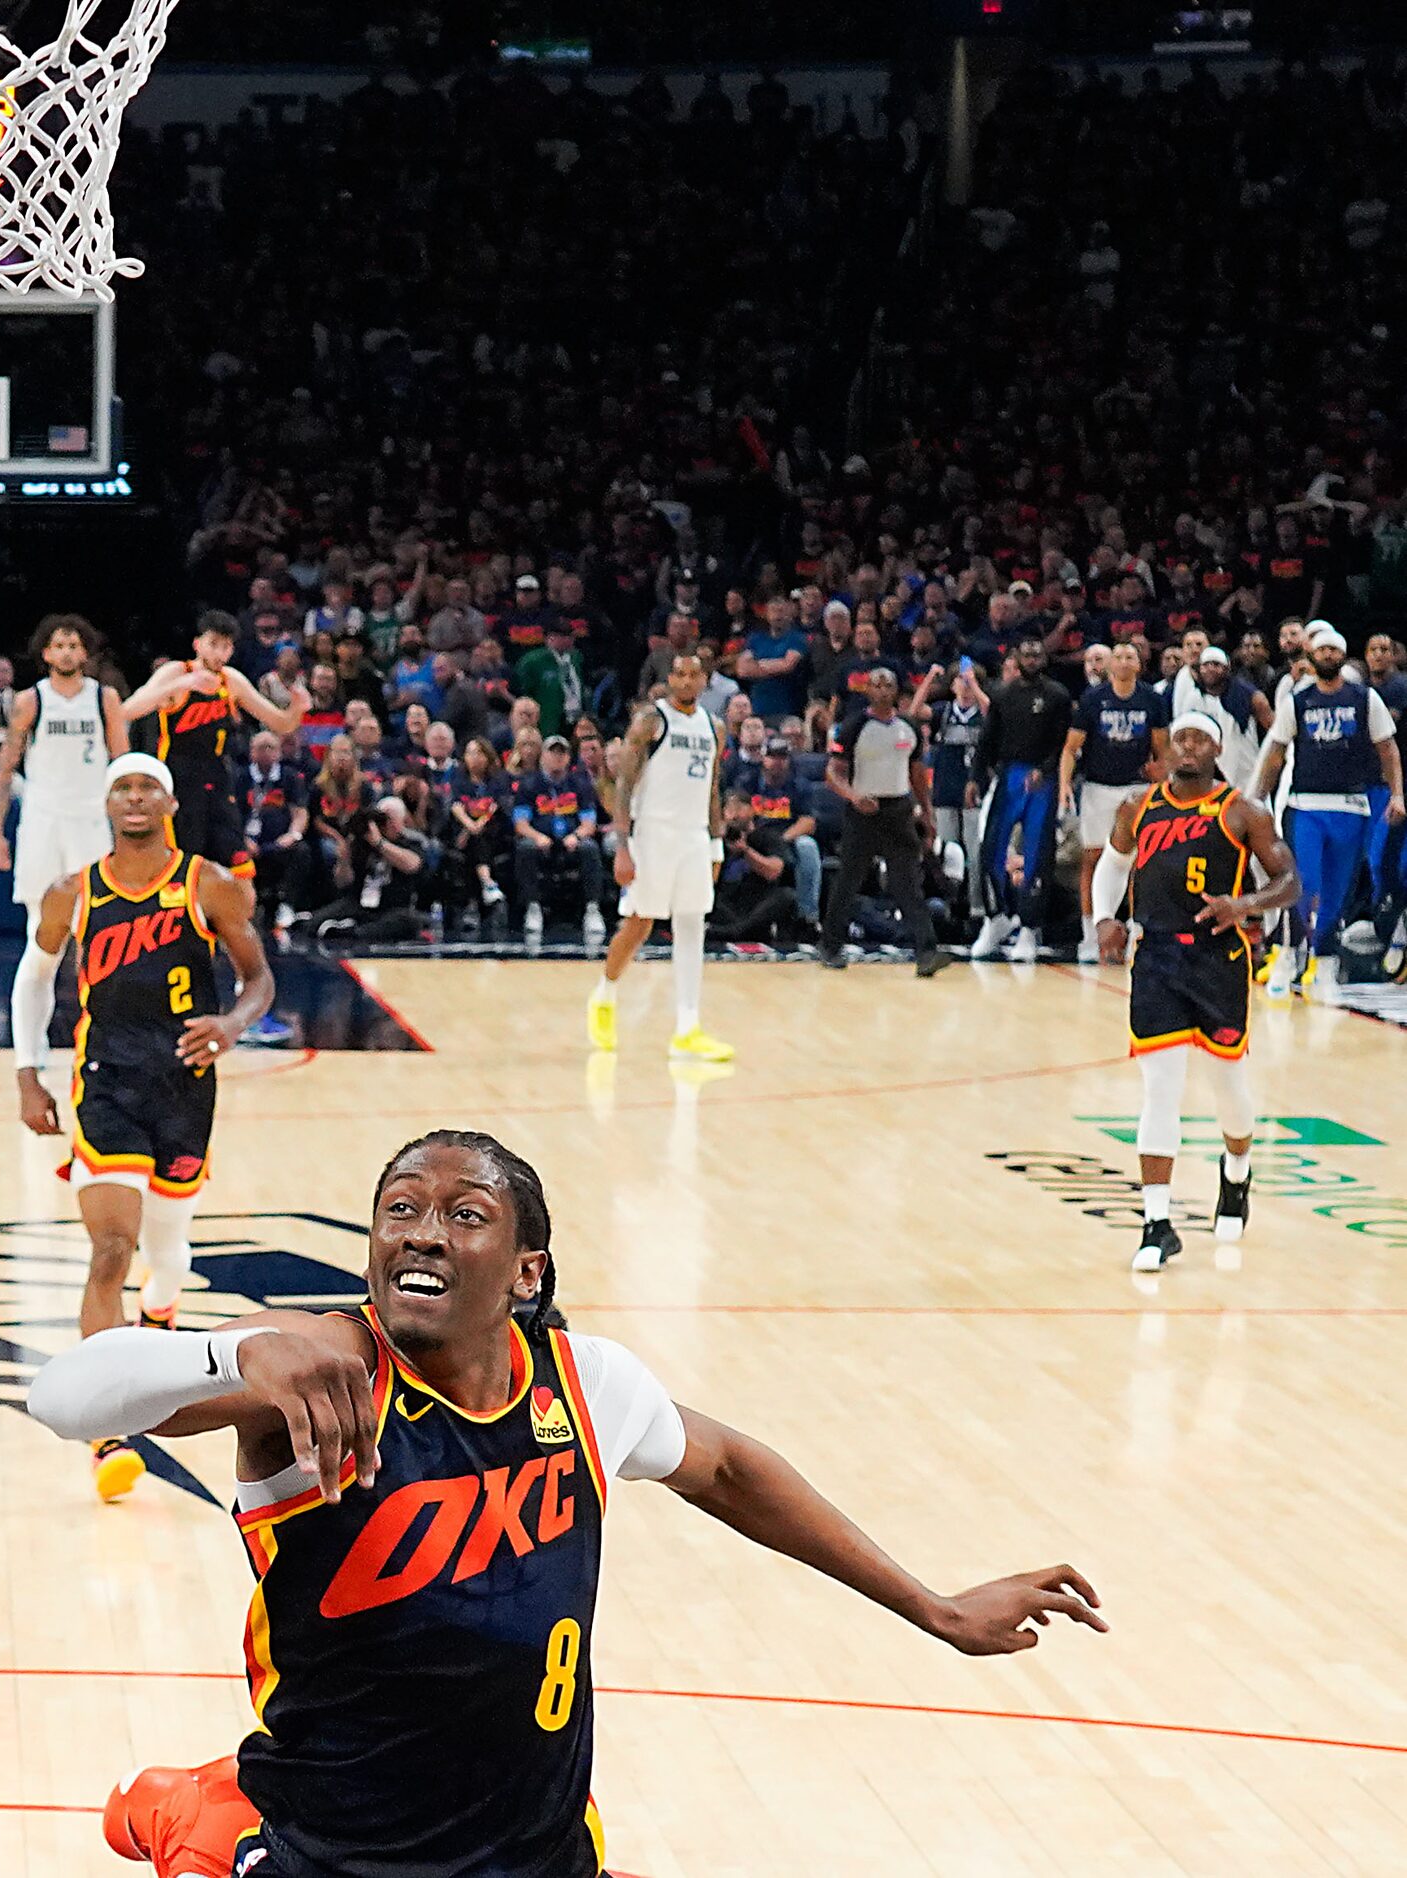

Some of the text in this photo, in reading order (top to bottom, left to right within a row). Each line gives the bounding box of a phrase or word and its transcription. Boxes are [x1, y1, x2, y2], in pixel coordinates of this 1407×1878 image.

[687, 754, 709, 779] 25
[1135, 815, 1214, 870] OKC
[1185, 856, 1208, 895] 5
[87, 906, 186, 986] OKC
[167, 965, 193, 1015] 2
[319, 1449, 576, 1618] OKC
[534, 1617, 581, 1732] 8
